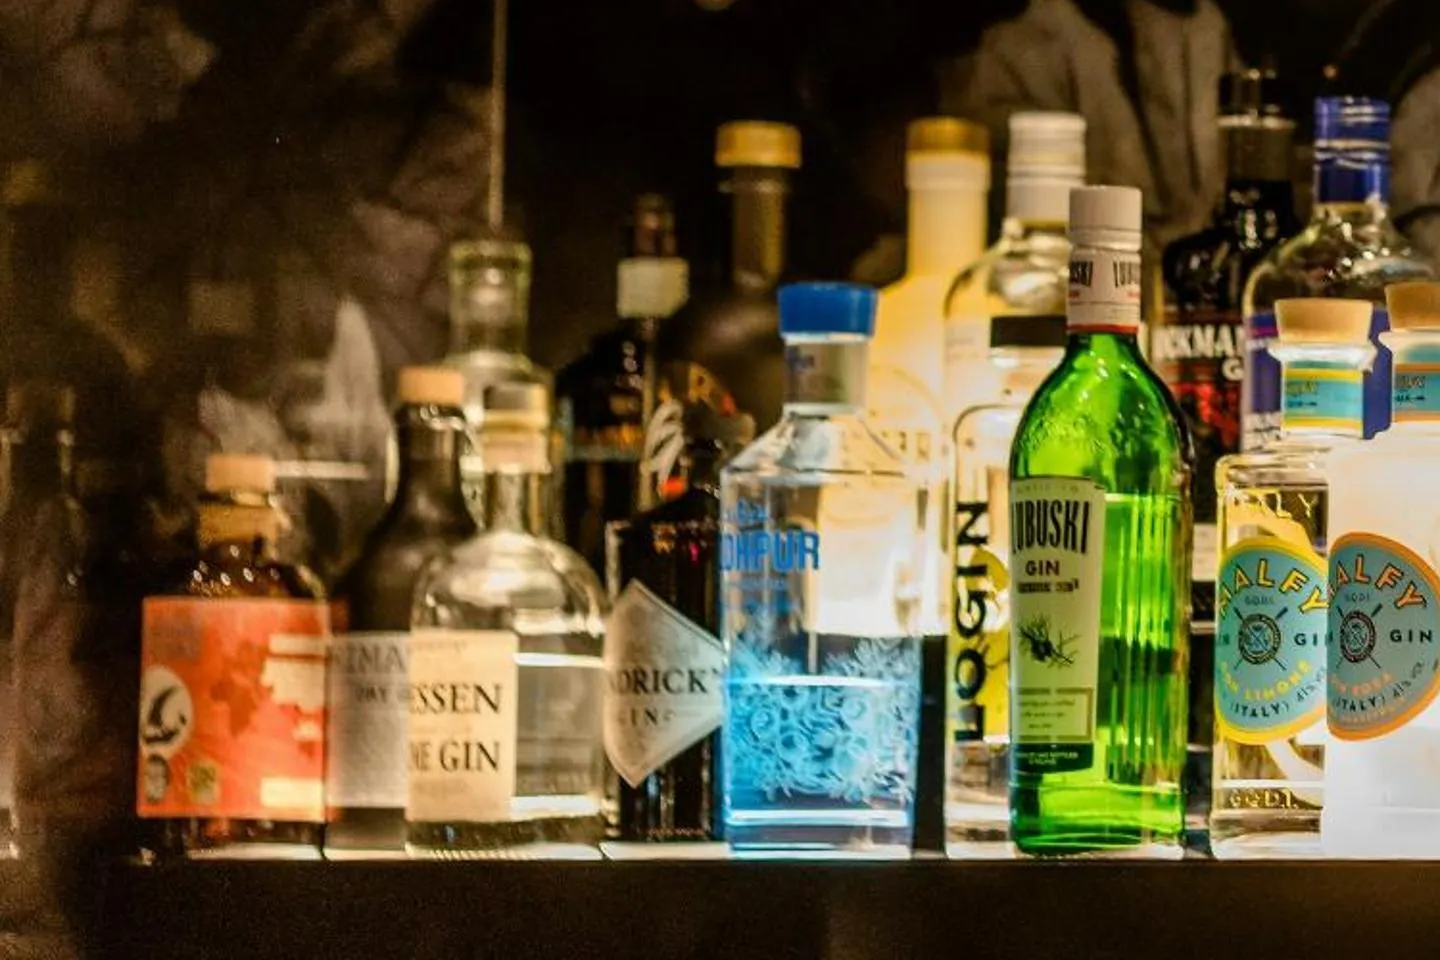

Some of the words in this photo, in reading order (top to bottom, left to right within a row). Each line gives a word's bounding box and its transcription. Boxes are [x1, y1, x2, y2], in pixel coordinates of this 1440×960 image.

[1025, 560, 1061, 577] GIN
[1389, 629, 1434, 644] GIN
[439, 741, 500, 773] GIN
